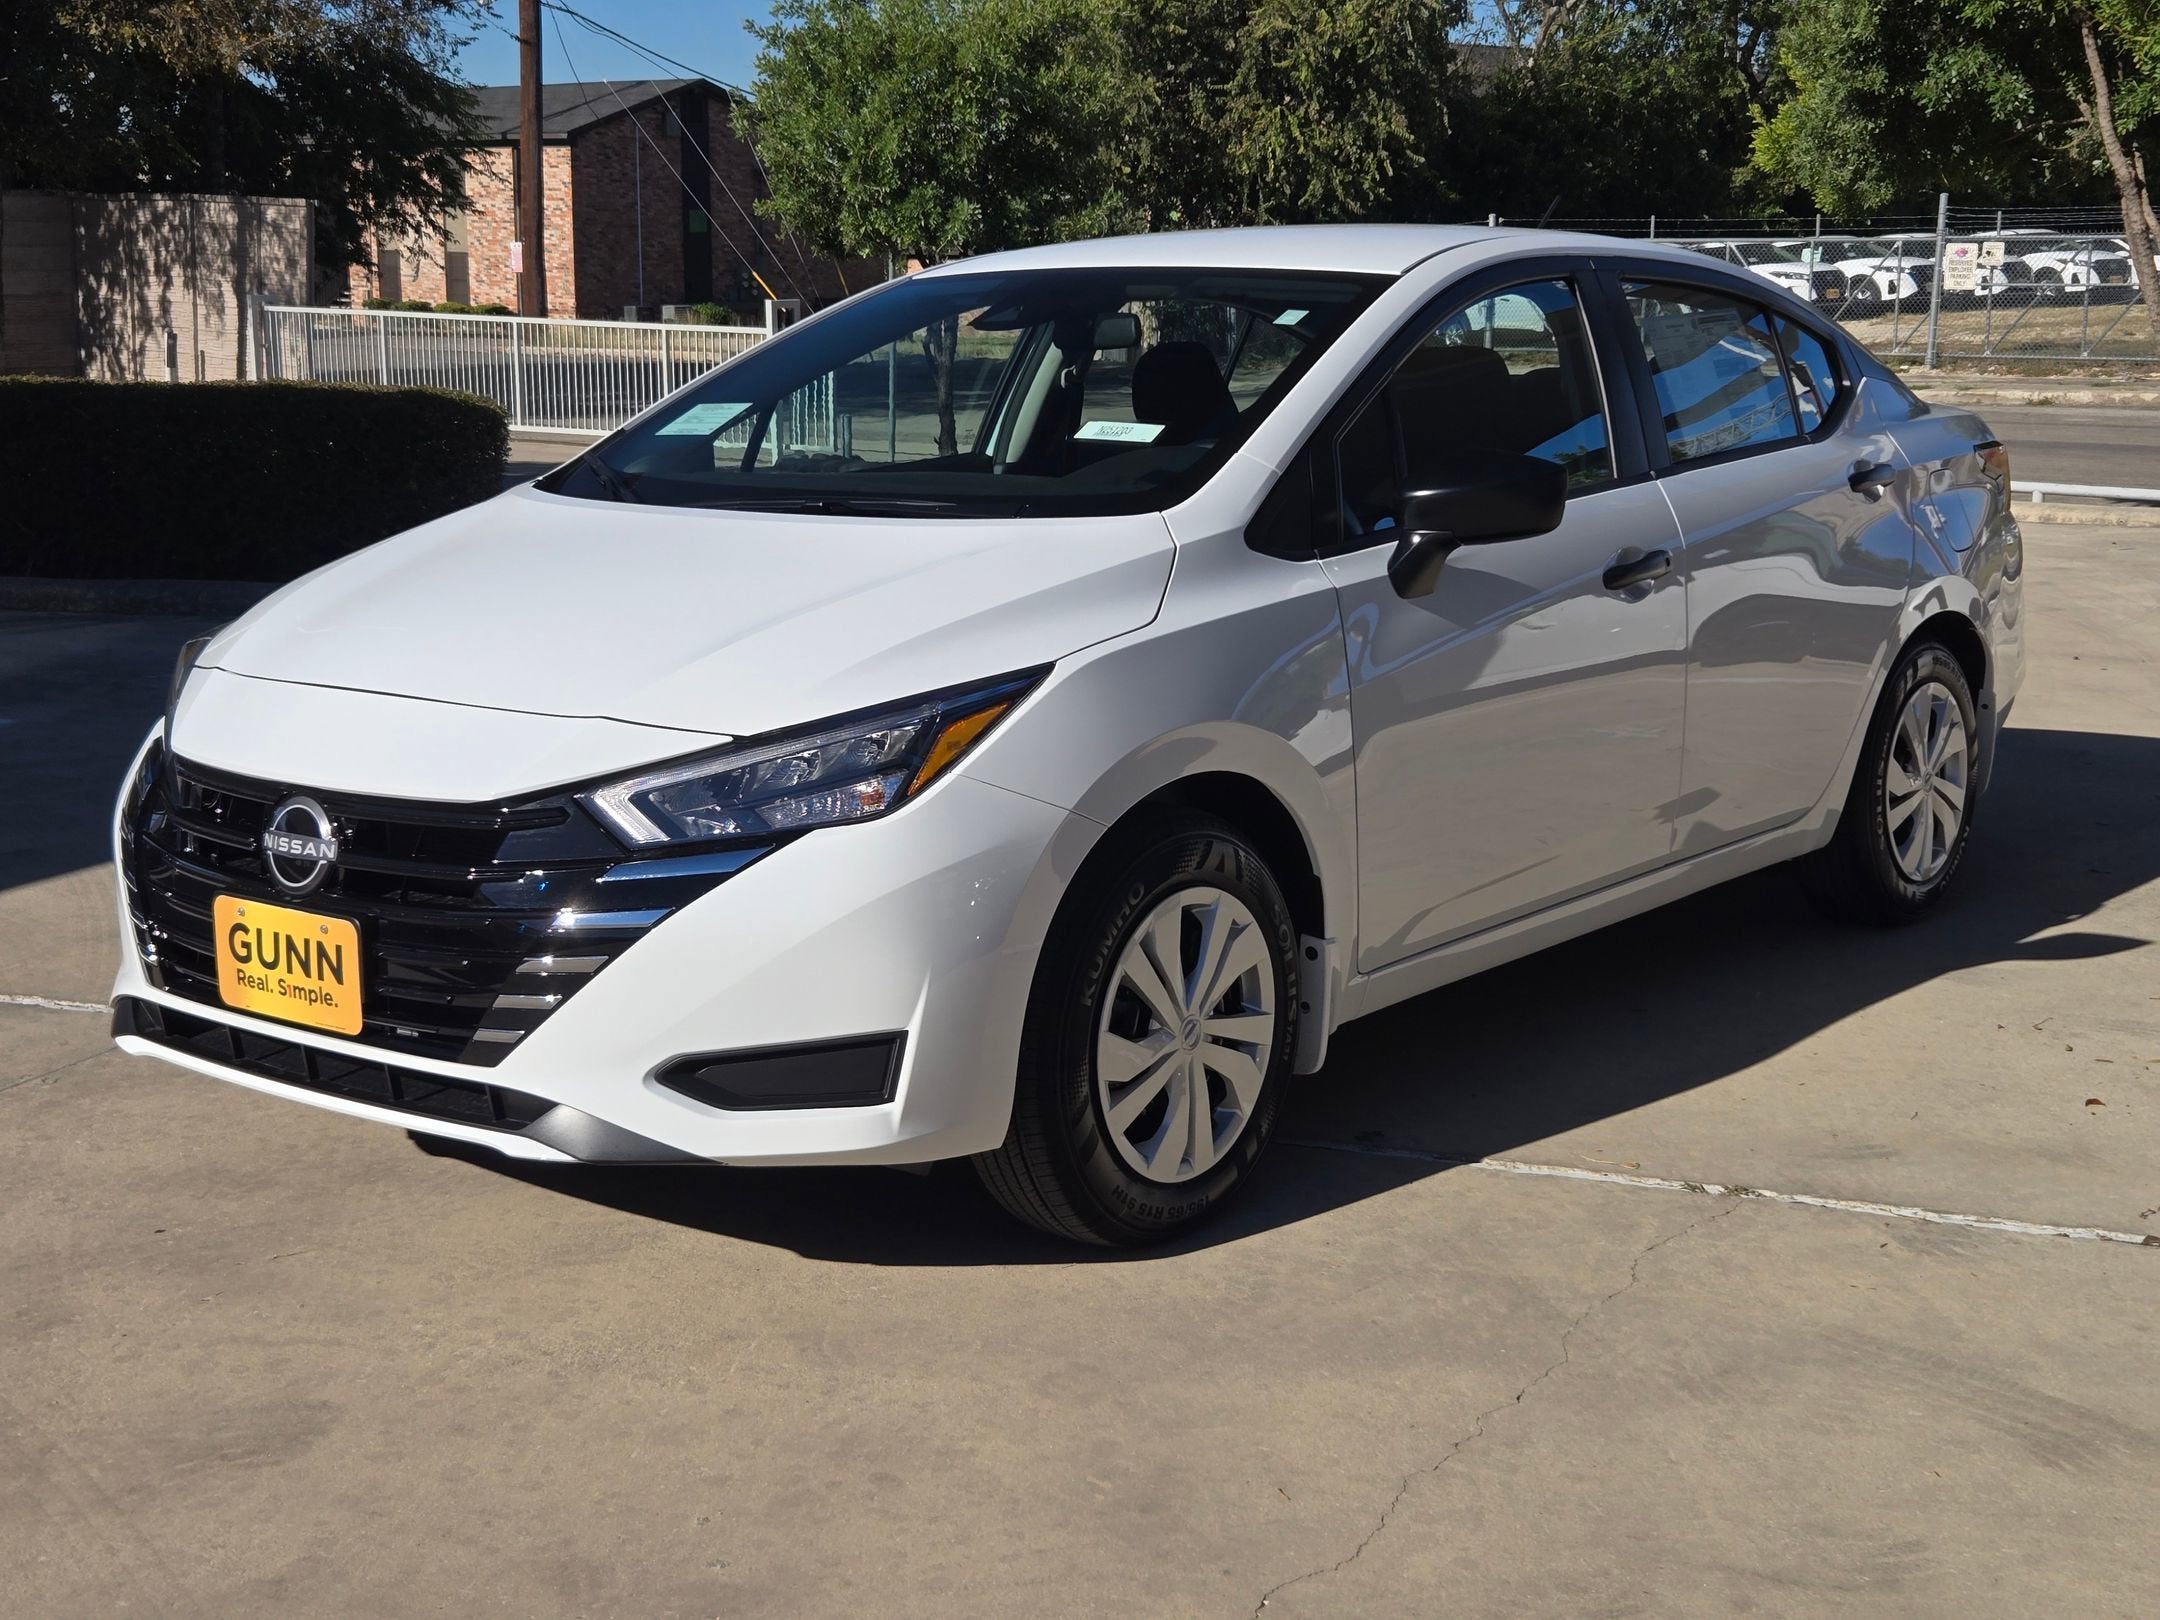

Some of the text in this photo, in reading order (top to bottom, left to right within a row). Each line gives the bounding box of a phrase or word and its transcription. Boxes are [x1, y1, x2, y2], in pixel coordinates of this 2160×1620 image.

[263, 832, 335, 858] NISSAN
[228, 922, 344, 986] GUNN
[1084, 882, 1146, 1006] KUMHO
[1273, 903, 1297, 1023] SOLUS
[237, 968, 274, 994] Real.
[1138, 1204, 1165, 1221] R15
[1166, 1194, 1210, 1221] 195/65
